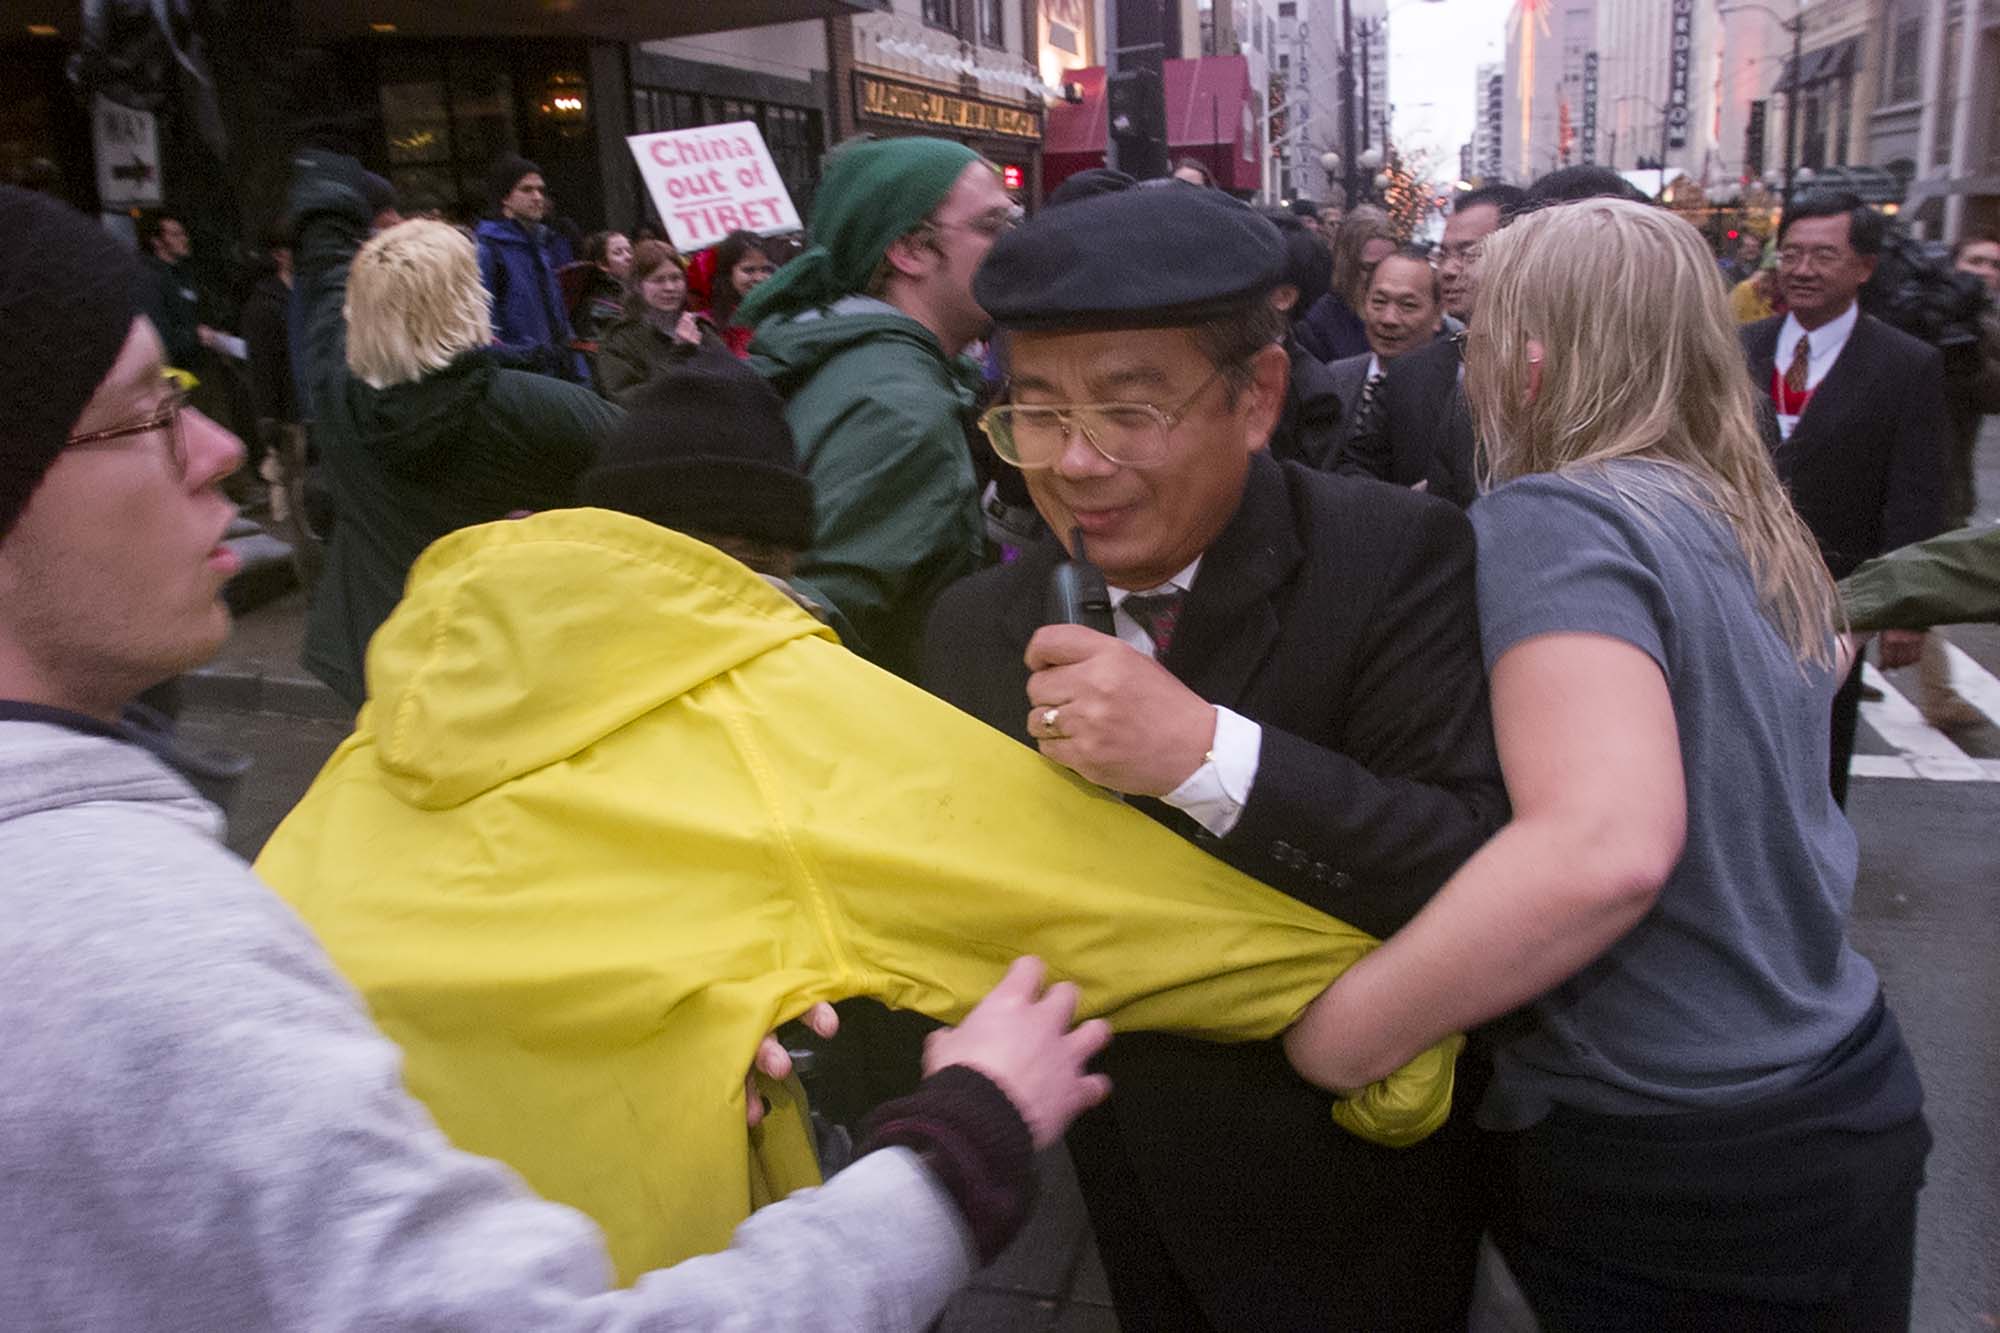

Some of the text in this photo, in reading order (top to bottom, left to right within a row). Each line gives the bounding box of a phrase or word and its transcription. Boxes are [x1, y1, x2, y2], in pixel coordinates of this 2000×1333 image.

[650, 136, 755, 168] China
[666, 160, 767, 199] out of
[674, 197, 784, 240] TIBET
